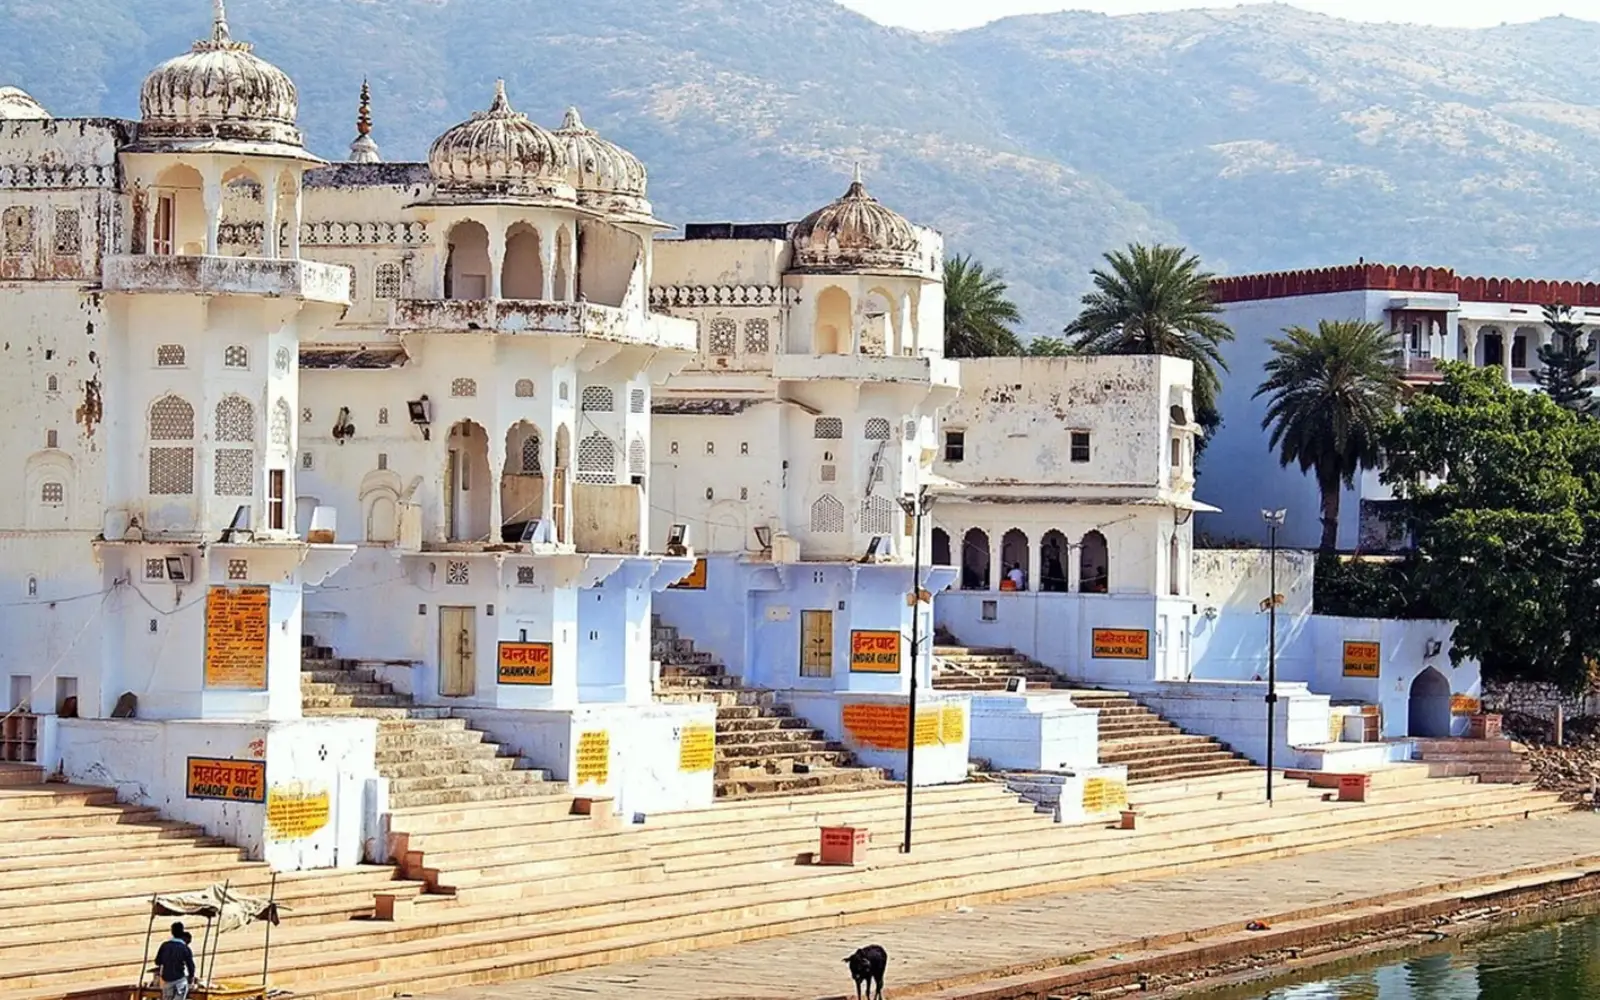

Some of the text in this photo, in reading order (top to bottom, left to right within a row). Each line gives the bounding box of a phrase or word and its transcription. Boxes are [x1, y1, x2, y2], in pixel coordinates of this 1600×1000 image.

[853, 653, 897, 665] INDRA GHAT
[500, 666, 536, 677] CHANDRA
[232, 786, 257, 798] GHAT
